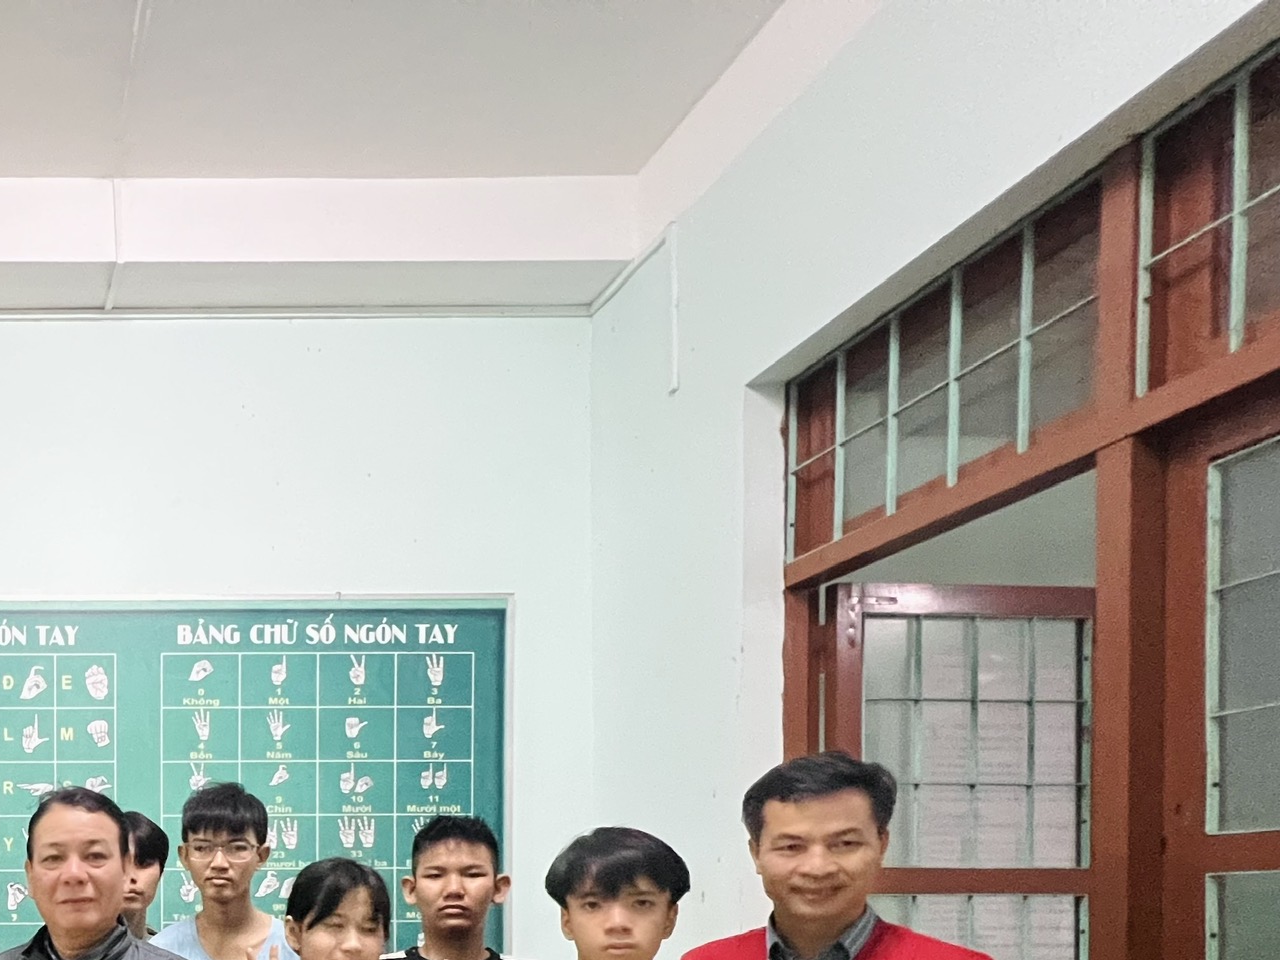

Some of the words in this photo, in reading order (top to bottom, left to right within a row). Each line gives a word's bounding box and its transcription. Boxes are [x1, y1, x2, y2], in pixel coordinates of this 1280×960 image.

[177, 619, 240, 646] BẢNG
[249, 619, 299, 645] CHỮ
[306, 613, 336, 645] SỐ
[344, 618, 407, 645] NGÓN
[415, 624, 458, 645] TAY
[35, 625, 80, 646] TAY
[2, 676, 15, 690] Đ
[62, 676, 72, 690] E
[354, 688, 361, 696] 2
[431, 688, 438, 696] 3
[348, 696, 367, 705] Hai
[427, 697, 443, 705] Ba
[3, 728, 14, 742] L
[60, 727, 74, 742] M
[3, 781, 14, 795] R
[351, 795, 364, 803] 10
[428, 795, 439, 803] 11
[3, 838, 14, 852] Y
